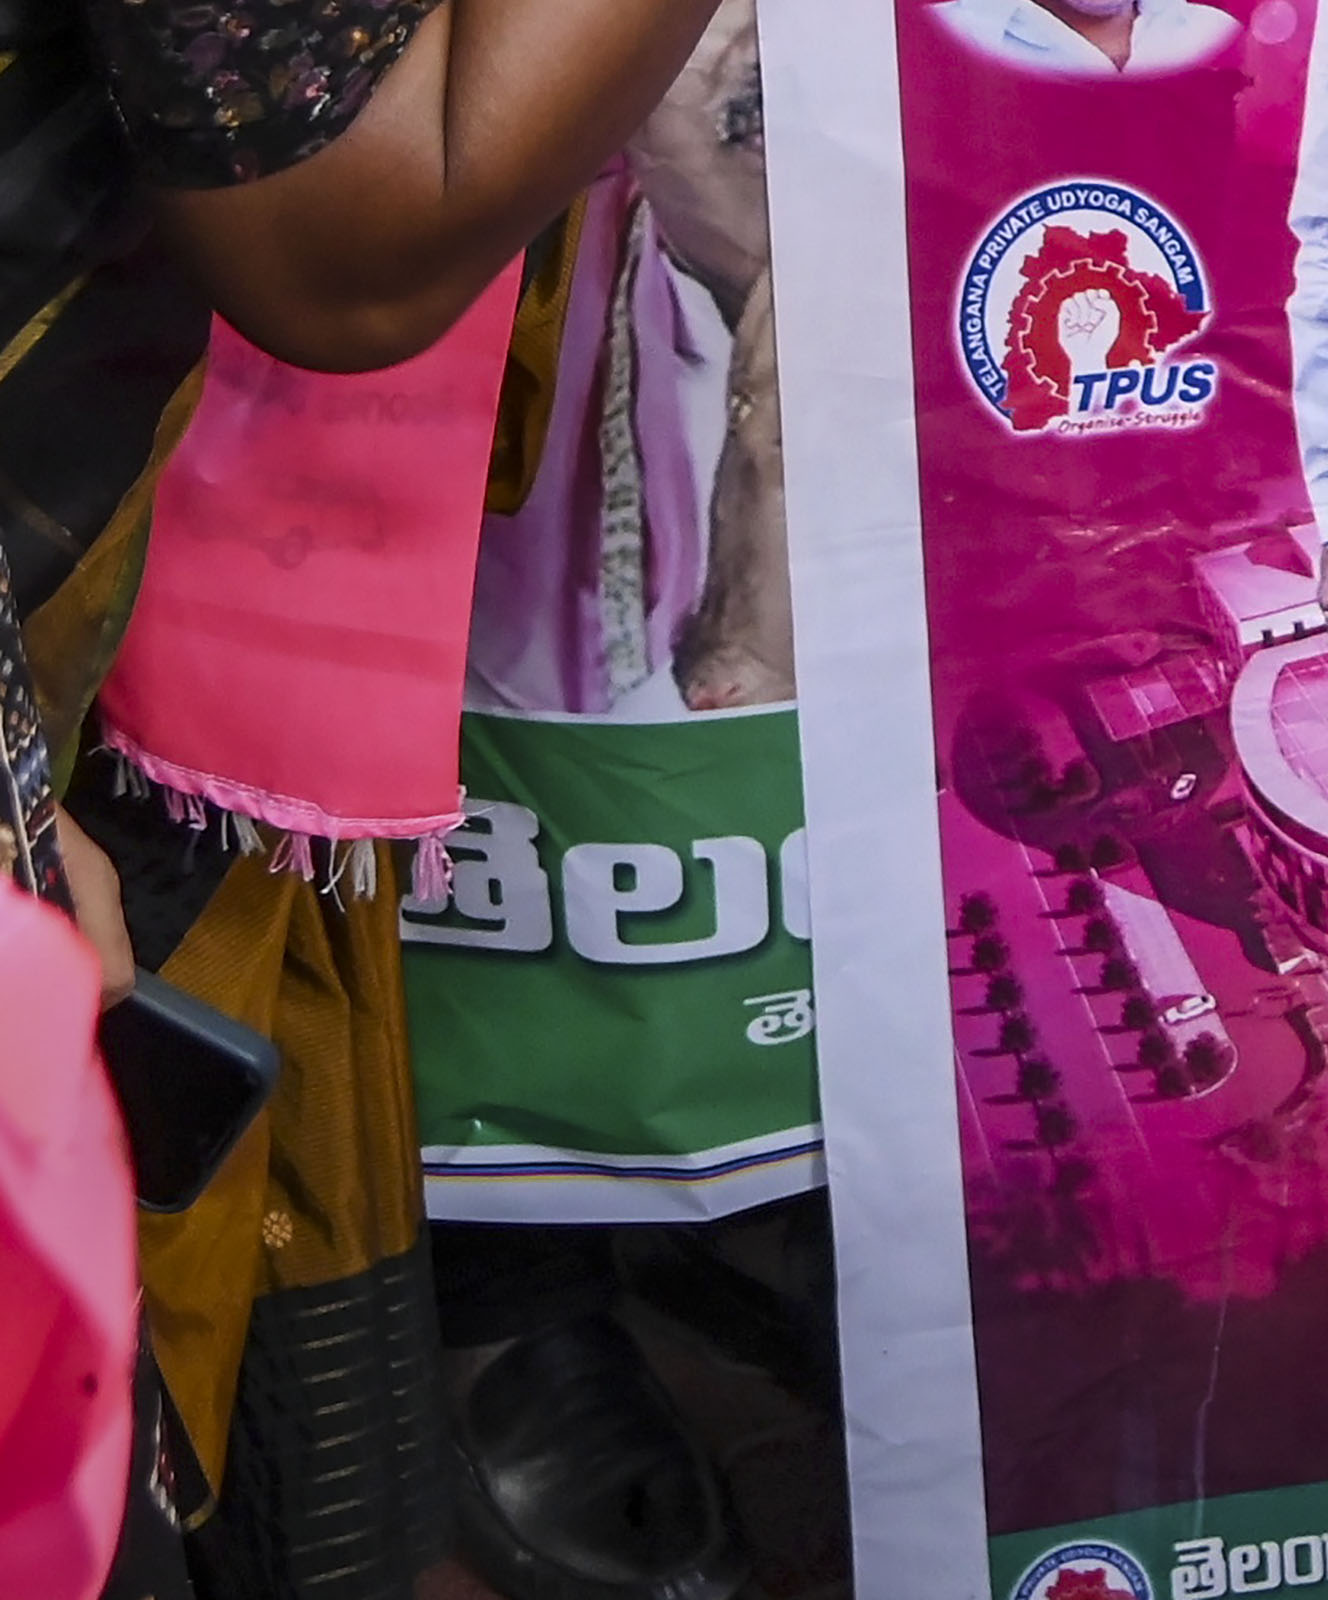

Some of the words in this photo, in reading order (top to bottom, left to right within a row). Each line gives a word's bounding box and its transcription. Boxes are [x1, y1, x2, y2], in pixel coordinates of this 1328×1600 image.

[978, 200, 1045, 270] PRIVATE
[1046, 188, 1132, 217] UDYOGA
[1133, 206, 1194, 285] SANGAM
[967, 274, 1006, 399] TELANGANA
[1073, 362, 1215, 412] TPUS
